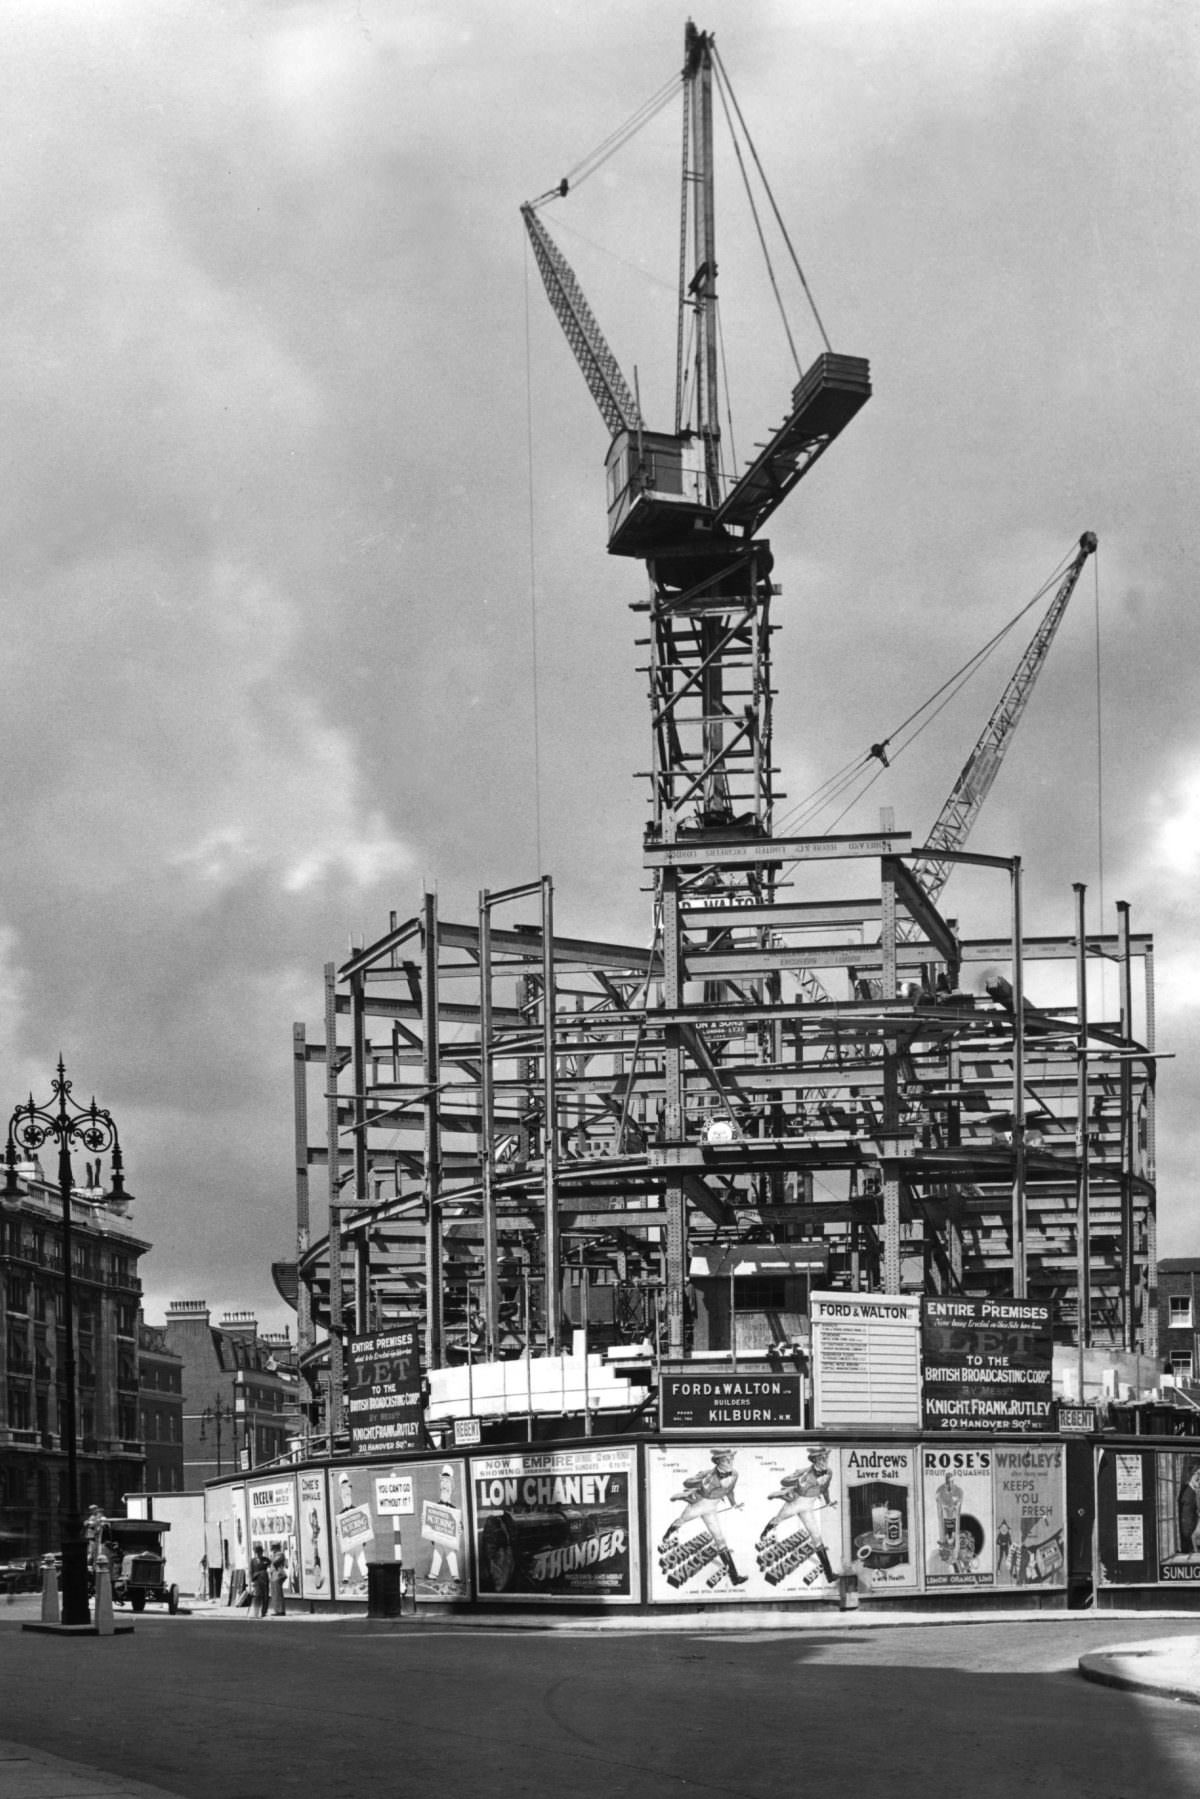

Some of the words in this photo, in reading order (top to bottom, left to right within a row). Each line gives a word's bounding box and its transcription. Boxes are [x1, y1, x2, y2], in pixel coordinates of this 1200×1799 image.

[821, 1304, 851, 1317] FORD
[854, 1307, 859, 1316] &
[861, 1306, 907, 1319] WALTON
[927, 1303, 975, 1317] ENTIRE
[982, 1304, 1048, 1320] PREMISES
[352, 1341, 374, 1354] ENTIRE
[377, 1333, 413, 1349] PREMISES
[939, 1329, 1035, 1355] LET
[966, 1355, 983, 1365] TO
[988, 1356, 1010, 1367] THE
[356, 1359, 411, 1386] LET
[925, 1367, 960, 1382] BRITISH
[962, 1368, 1026, 1383] BROADCASTING
[371, 1385, 382, 1395] TO
[383, 1384, 397, 1393] THE
[673, 1383, 712, 1396] FORD
[714, 1385, 721, 1395] &
[723, 1383, 781, 1395] WALTON
[972, 1399, 1008, 1415] FRANK
[1011, 1400, 1051, 1416] RUTLEY
[941, 1418, 958, 1428] 20
[960, 1419, 1010, 1429] HANOVER
[1060, 1411, 1092, 1427] REGENT
[397, 1422, 419, 1437] RUTLEY
[368, 1442, 395, 1452] HANOVER
[485, 1460, 510, 1469] NOW
[522, 1455, 574, 1469] EMPIRE
[848, 1451, 908, 1469] Andrews
[925, 1452, 990, 1468] ROSE'S
[996, 1453, 1062, 1469] WRIGLEY'S
[480, 1467, 521, 1476] SHOWING
[857, 1470, 879, 1479] Liver
[882, 1470, 899, 1478] Salt
[953, 1469, 990, 1477] SQUASHES
[480, 1479, 518, 1506] LON
[523, 1475, 610, 1505] CHANEY
[611, 1484, 620, 1494] in
[1003, 1480, 1035, 1491] KEEPS
[1015, 1494, 1039, 1504] YOU
[1022, 1506, 1053, 1516] FRESH
[533, 1528, 627, 1581] THUNDER
[659, 1531, 714, 1575] JOHNNIE
[757, 1529, 812, 1573] JOHNNIE
[1163, 1566, 1200, 1579] SUNLIG
